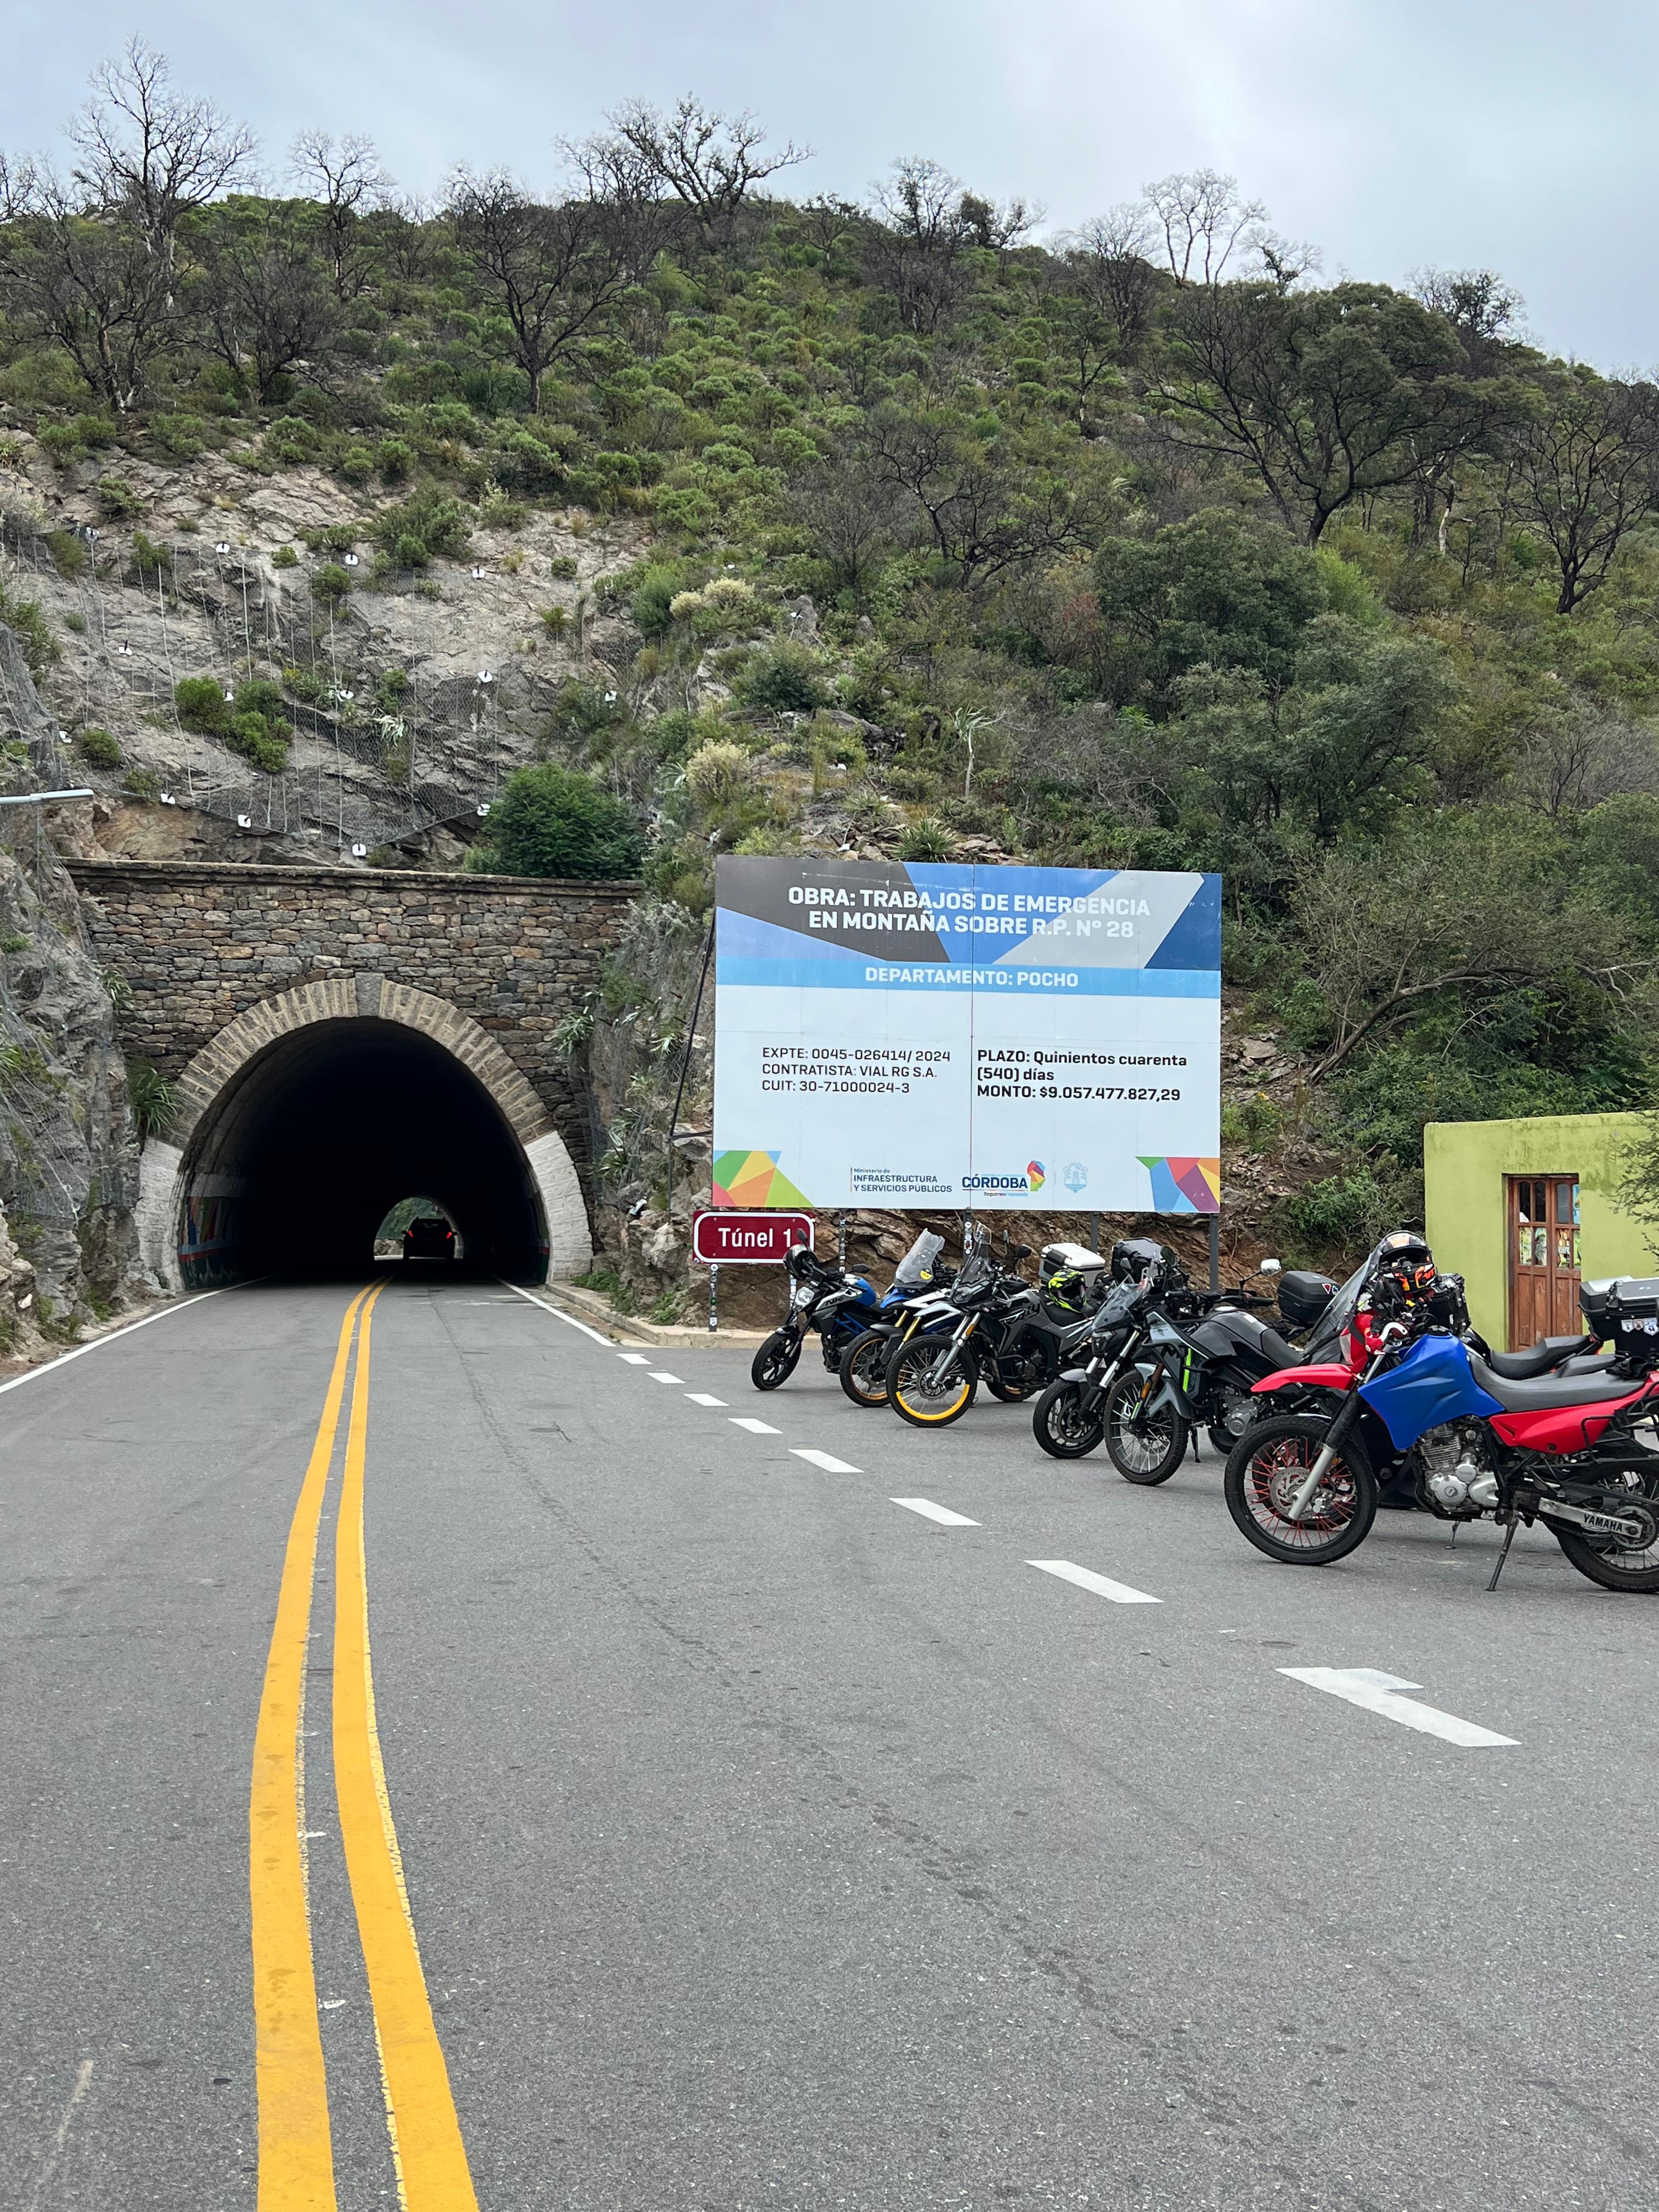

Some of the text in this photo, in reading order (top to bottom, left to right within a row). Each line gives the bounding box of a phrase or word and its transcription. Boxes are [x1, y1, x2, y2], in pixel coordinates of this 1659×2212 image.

[788, 887, 1150, 916] OBRA: TRABAJOS DE EMERGENCIA
[809, 911, 837, 929] EN
[843, 910, 950, 932] MONTAÑA
[955, 915, 1027, 934] SOBRE
[1032, 918, 1071, 936] R.P.
[1106, 921, 1133, 938] 28
[865, 967, 1079, 987] DEPARTAMENTO: POCHO
[763, 1047, 808, 1059] EXPTE:
[916, 1051, 950, 1062] 2024
[977, 1049, 1187, 1066] PLAZO: Quinientos cuarenta
[762, 1064, 938, 1077] CONTRATISTA: VIAL RG S.A.
[977, 1067, 1054, 1082] (540) días
[762, 1080, 910, 1093] CUIT: 30-71000024-3
[977, 1085, 1181, 1102] MONTO: $9.057.477.827,29
[909, 1183, 952, 1193] PÚBLICOS
[962, 1173, 1028, 1189] CÓRDOBA
[718, 1228, 791, 1248] Túnel 1
[1584, 1514, 1622, 1532] YAMAHA
